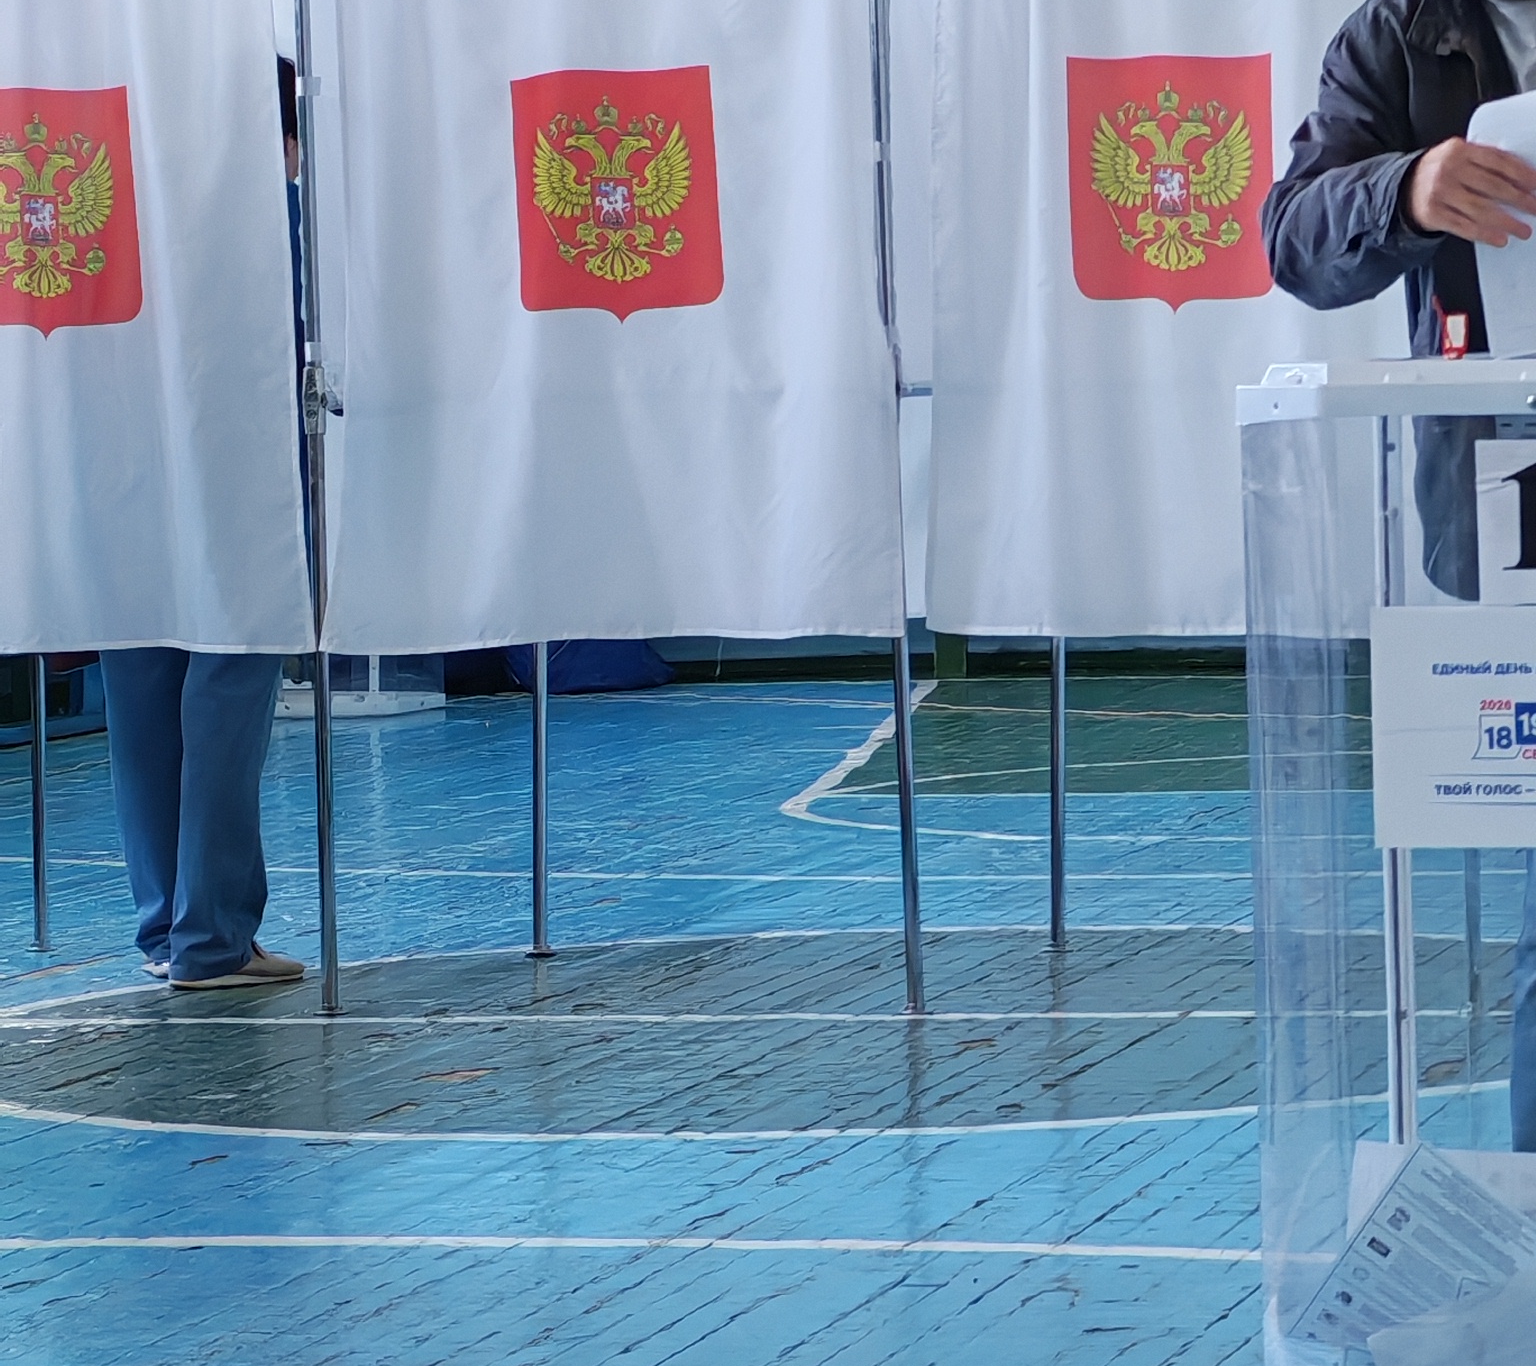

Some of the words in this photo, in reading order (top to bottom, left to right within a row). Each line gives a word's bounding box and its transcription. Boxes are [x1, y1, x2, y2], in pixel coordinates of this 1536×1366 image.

[1431, 659, 1492, 675] ЕДИНЫЙ
[1494, 662, 1532, 675] ДЕНЬ
[1483, 726, 1513, 750] 18
[1434, 782, 1472, 795] ТВОЙ
[1476, 784, 1523, 795] ГОЛОС
